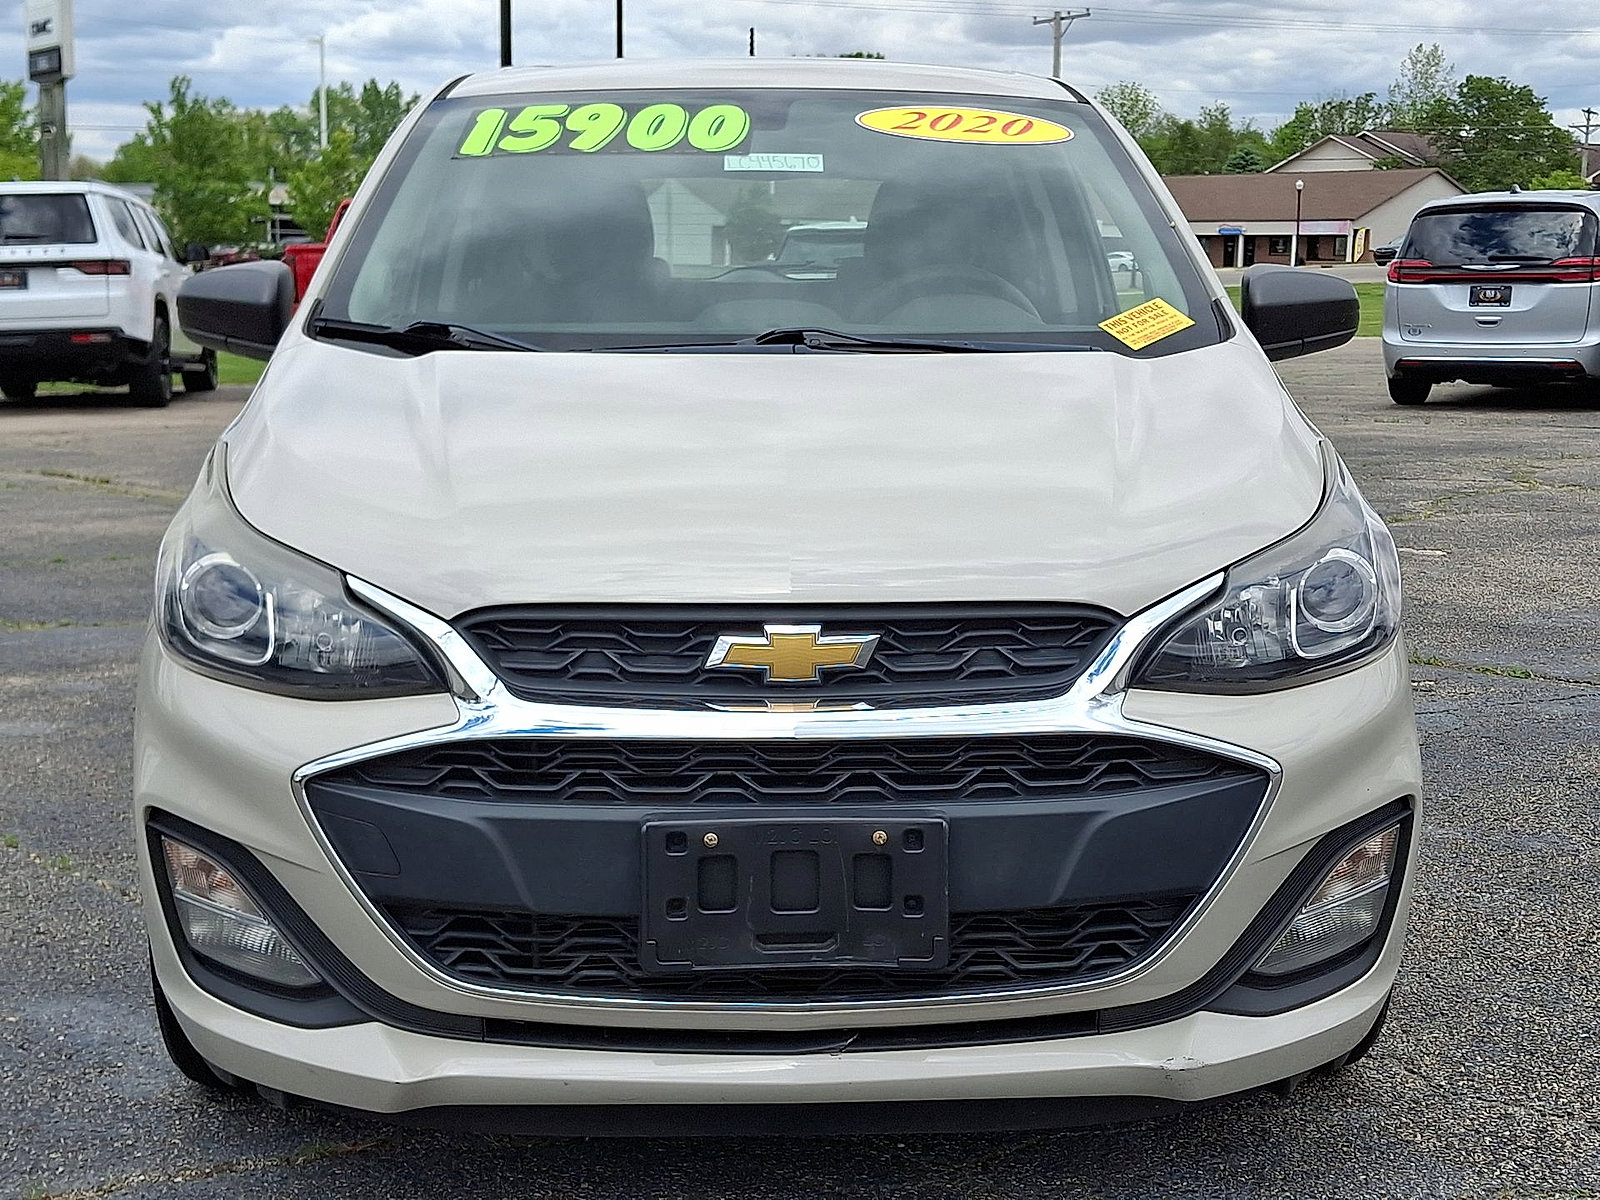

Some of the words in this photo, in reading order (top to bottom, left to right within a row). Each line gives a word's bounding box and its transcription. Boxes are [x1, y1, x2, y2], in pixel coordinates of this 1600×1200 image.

[459, 102, 751, 156] 15900
[890, 111, 1034, 137] 2020
[1103, 317, 1128, 330] THIS
[1126, 302, 1163, 321] VEHICLE
[1115, 325, 1132, 335] NOT
[1132, 318, 1150, 329] FOR
[1148, 309, 1169, 321] SALE
